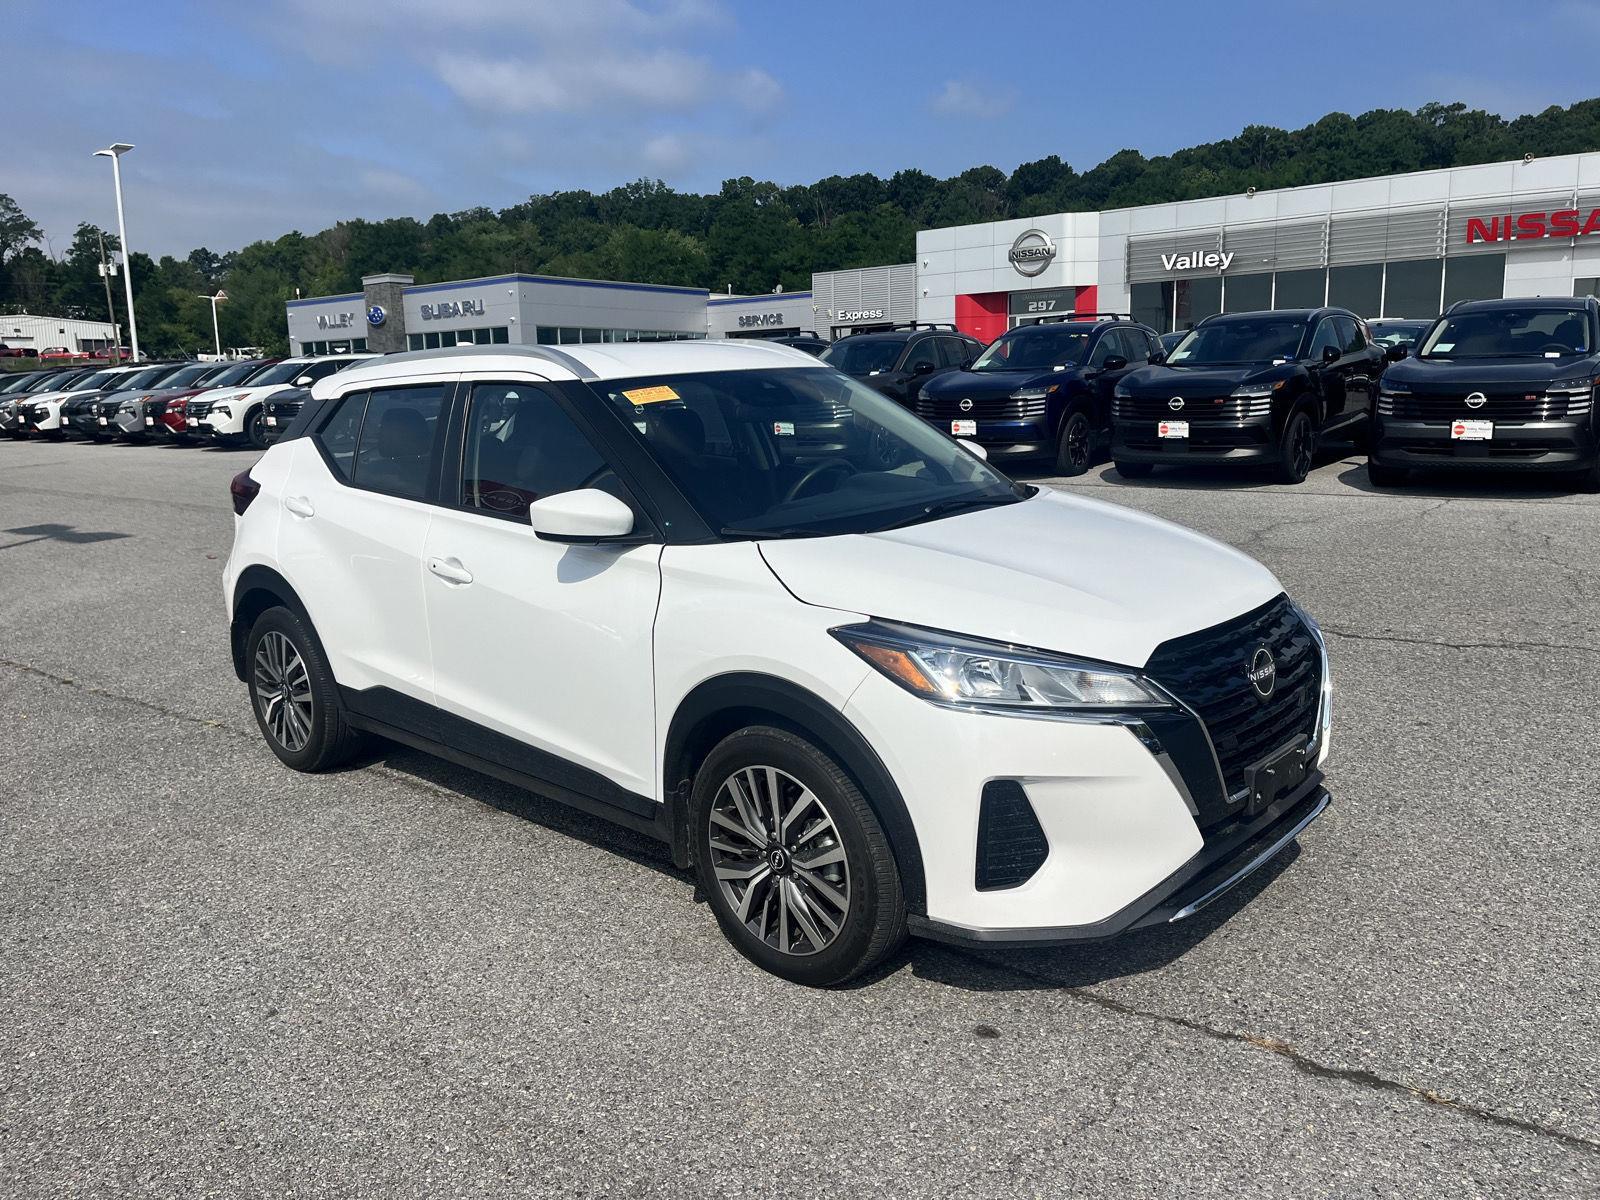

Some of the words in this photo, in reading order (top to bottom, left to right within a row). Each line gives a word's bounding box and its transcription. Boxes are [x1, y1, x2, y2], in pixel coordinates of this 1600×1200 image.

[1011, 247, 1051, 260] NISSAN
[1161, 250, 1235, 271] Valley
[420, 299, 485, 321] SUBARU
[1028, 300, 1056, 312] 297
[316, 312, 355, 330] VALLEY
[738, 312, 783, 328] SERVICE
[838, 309, 883, 322] Express
